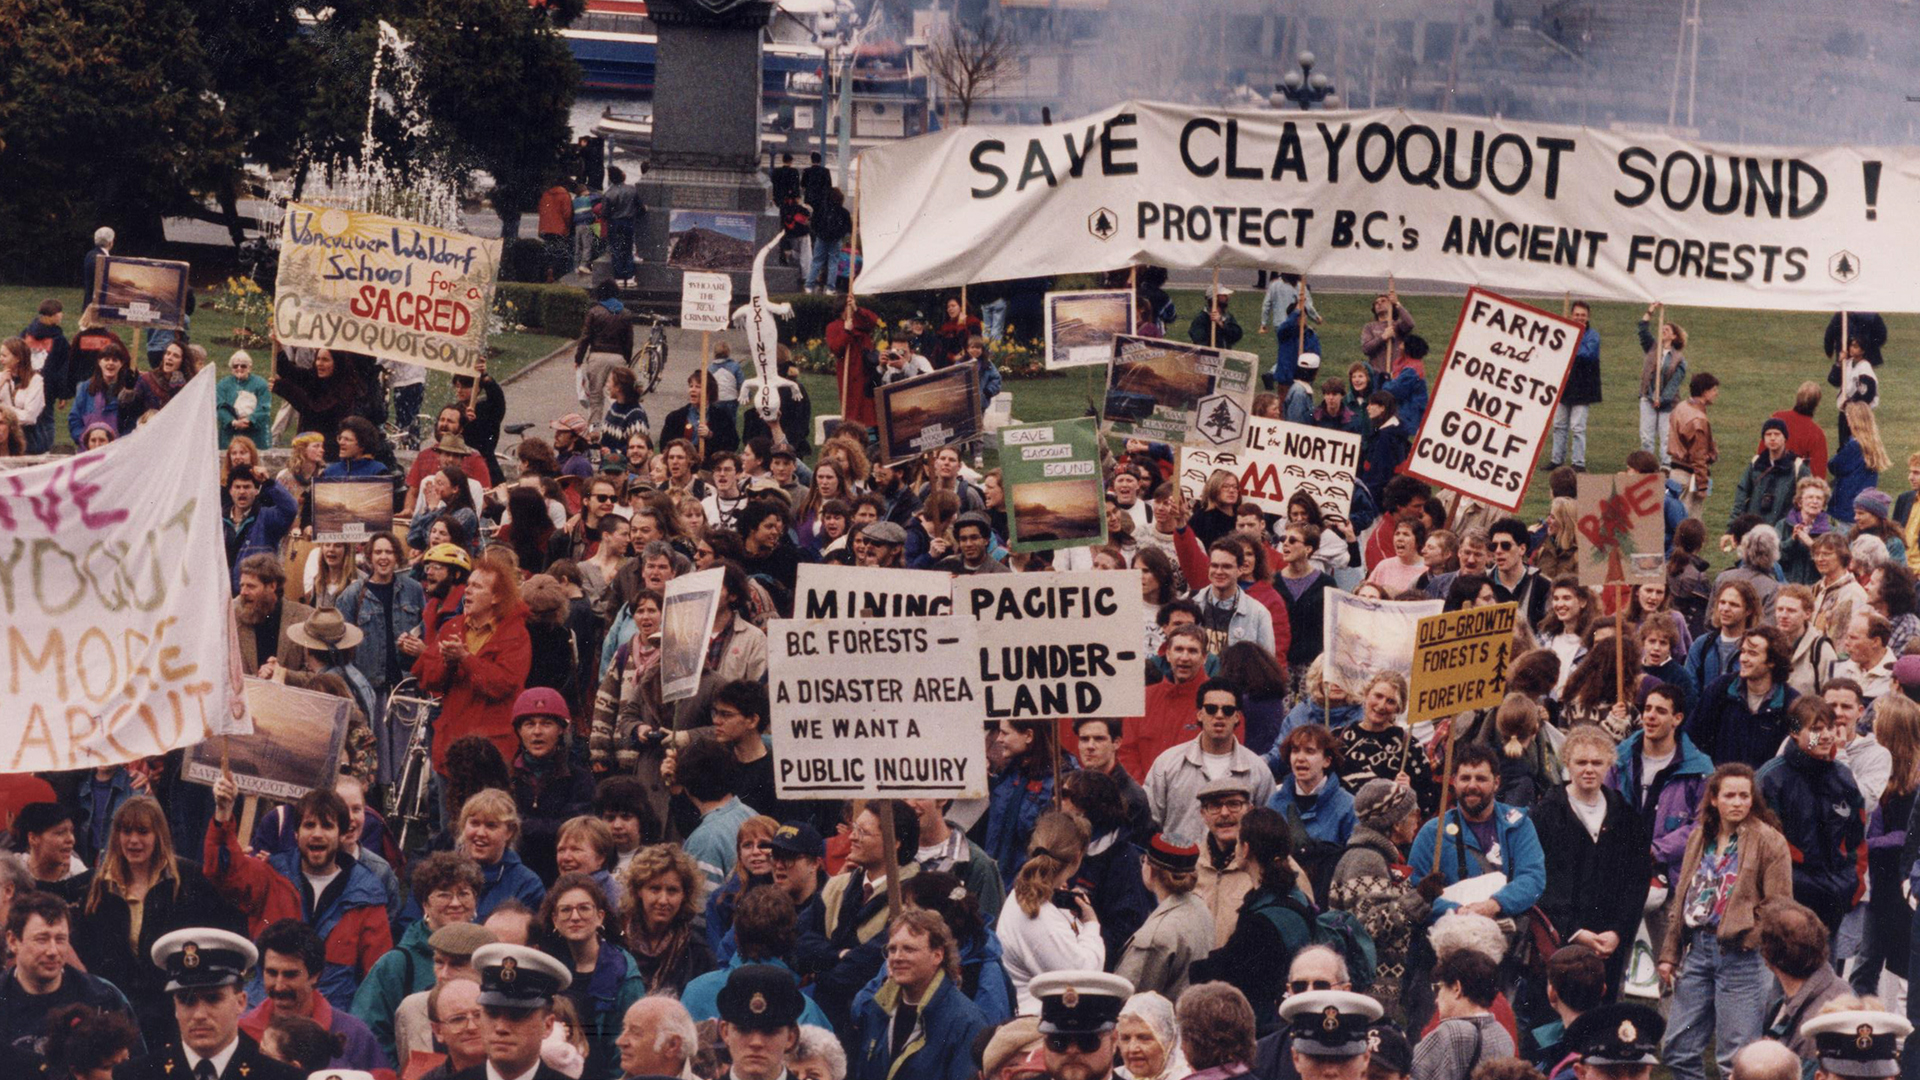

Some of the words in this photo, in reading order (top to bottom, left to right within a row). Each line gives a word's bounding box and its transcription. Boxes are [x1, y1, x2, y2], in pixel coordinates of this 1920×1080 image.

[969, 113, 1138, 200] SAVE
[1179, 117, 1576, 201] CLAYOQUOT
[1613, 146, 1829, 220] SOUND
[1861, 160, 1883, 221] !
[390, 227, 478, 275] Waldorf
[1137, 201, 1314, 248] PROTECT
[1442, 214, 1608, 268] ANCIENT
[1626, 234, 1809, 283] FORESTS
[322, 253, 413, 288] School
[427, 270, 458, 297] for
[466, 287, 481, 300] a
[350, 284, 472, 337] SACRED
[696, 303, 715, 312] REAL
[700, 292, 714, 301] THE
[684, 313, 728, 323] CRIMINALS
[1471, 299, 1567, 351] FARMS
[1490, 341, 1536, 364] and
[1449, 350, 1559, 407] FORESTS
[1466, 387, 1523, 426] NOT
[1010, 430, 1047, 442] SAVE
[1267, 426, 1278, 434] of
[1267, 438, 1282, 447] the
[1440, 410, 1528, 459] GOLF
[1284, 432, 1356, 468] NORTH
[1416, 436, 1523, 493] COURSES
[1045, 462, 1094, 476] SOUND
[0, 454, 130, 534] VE
[970, 586, 1118, 622] PACIFIC
[828, 627, 929, 655] FORESTS
[1419, 606, 1516, 645] OLD-GROWTH
[1422, 641, 1490, 674] FORESTS
[776, 680, 791, 705] A
[797, 677, 903, 705] DISASTER
[913, 676, 974, 703] AREA
[984, 681, 1103, 718] LAND
[1417, 678, 1486, 713] FOREVER
[791, 719, 824, 740] WE
[832, 718, 899, 740] WANT
[906, 718, 921, 739] A
[191, 765, 221, 781] SAVE
[780, 757, 865, 783] PUBLIC
[875, 757, 969, 783] INQUIRY
